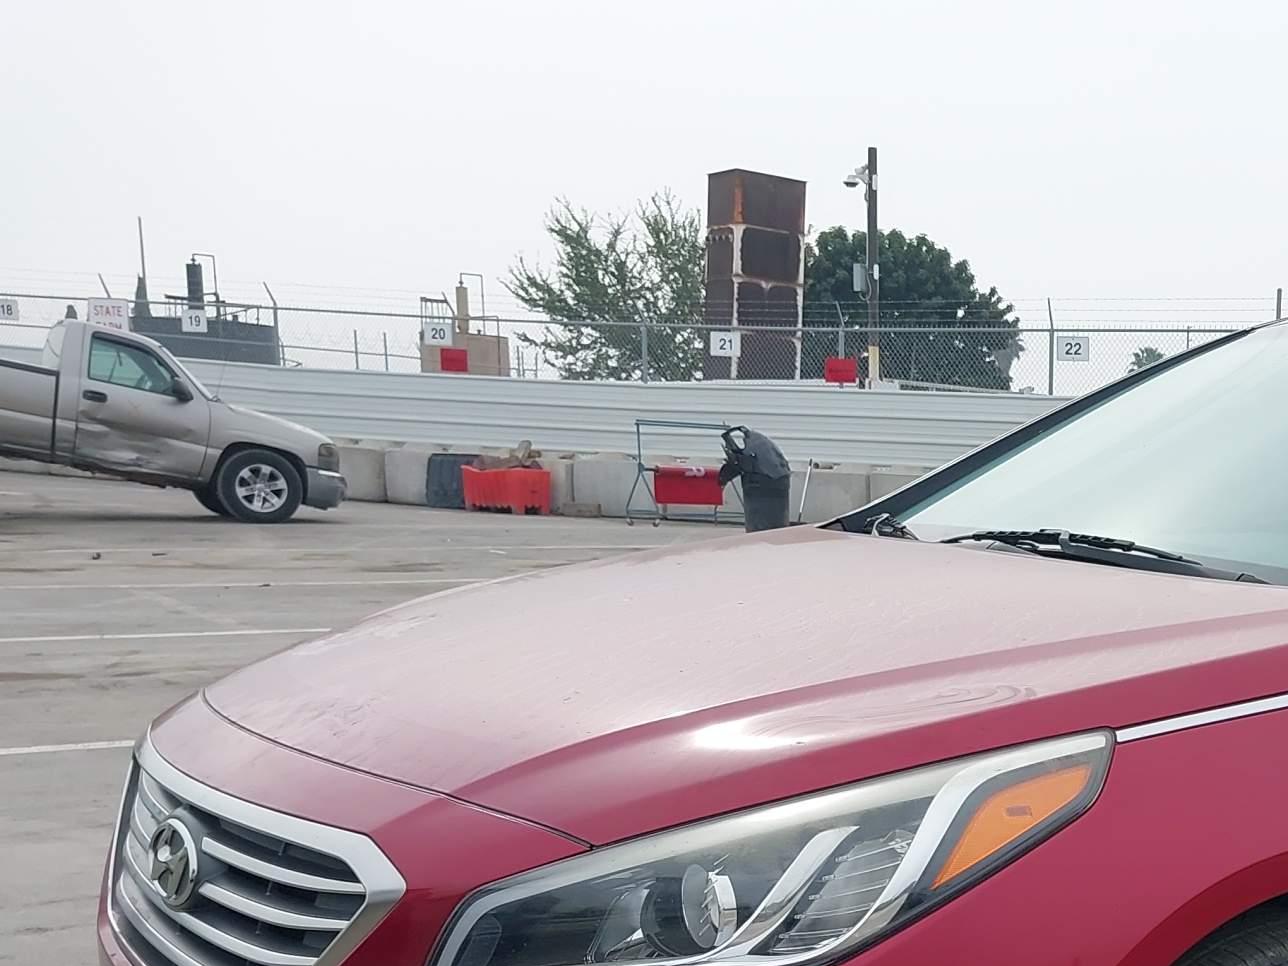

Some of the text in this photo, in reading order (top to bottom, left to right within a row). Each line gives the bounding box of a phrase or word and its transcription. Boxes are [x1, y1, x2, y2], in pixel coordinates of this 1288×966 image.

[0, 304, 13, 316] 18
[93, 304, 123, 317] STATE
[188, 315, 201, 327] 19
[431, 327, 446, 341] 20
[719, 337, 733, 351] 21
[1065, 342, 1082, 356] 22
